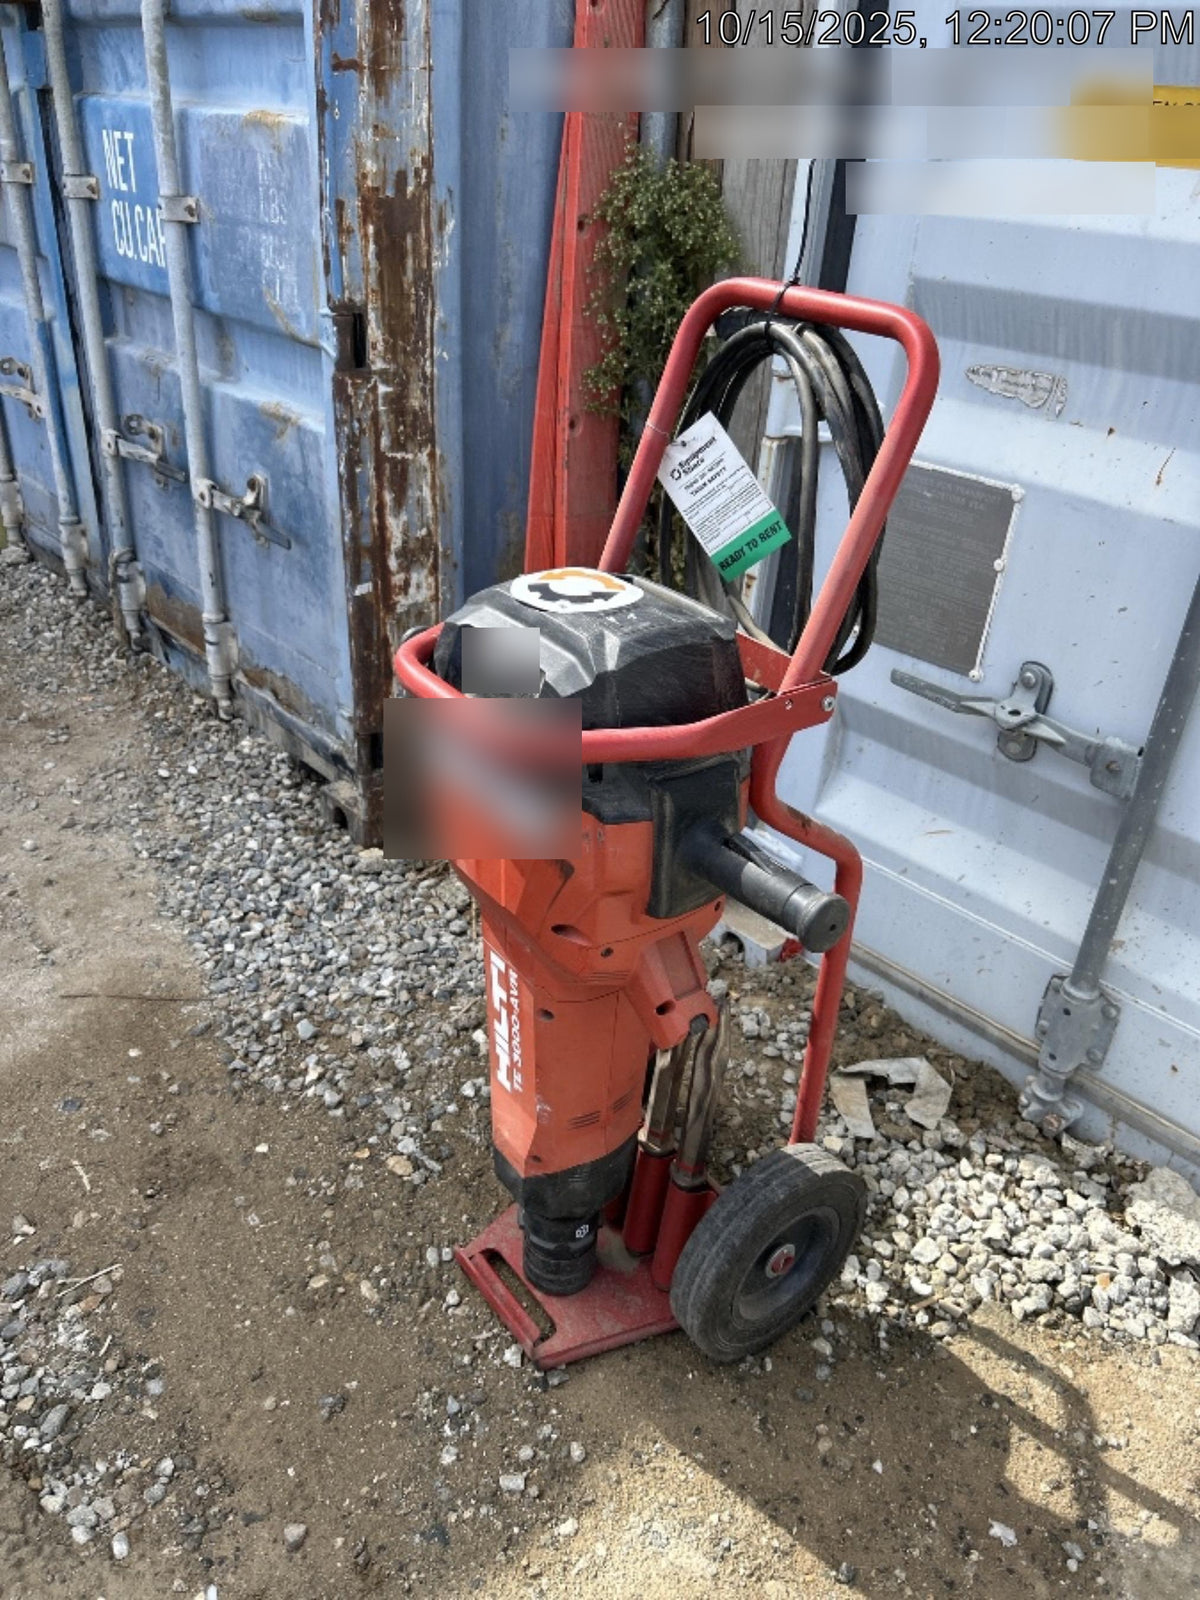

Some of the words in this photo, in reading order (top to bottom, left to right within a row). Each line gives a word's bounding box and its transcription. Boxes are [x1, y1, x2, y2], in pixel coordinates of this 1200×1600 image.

[102, 129, 136, 193] NET
[718, 546, 746, 572] READY
[744, 538, 759, 552] TO
[758, 520, 782, 543] RENT
[490, 951, 511, 1093] HILTI
[513, 1068, 524, 1093] TE
